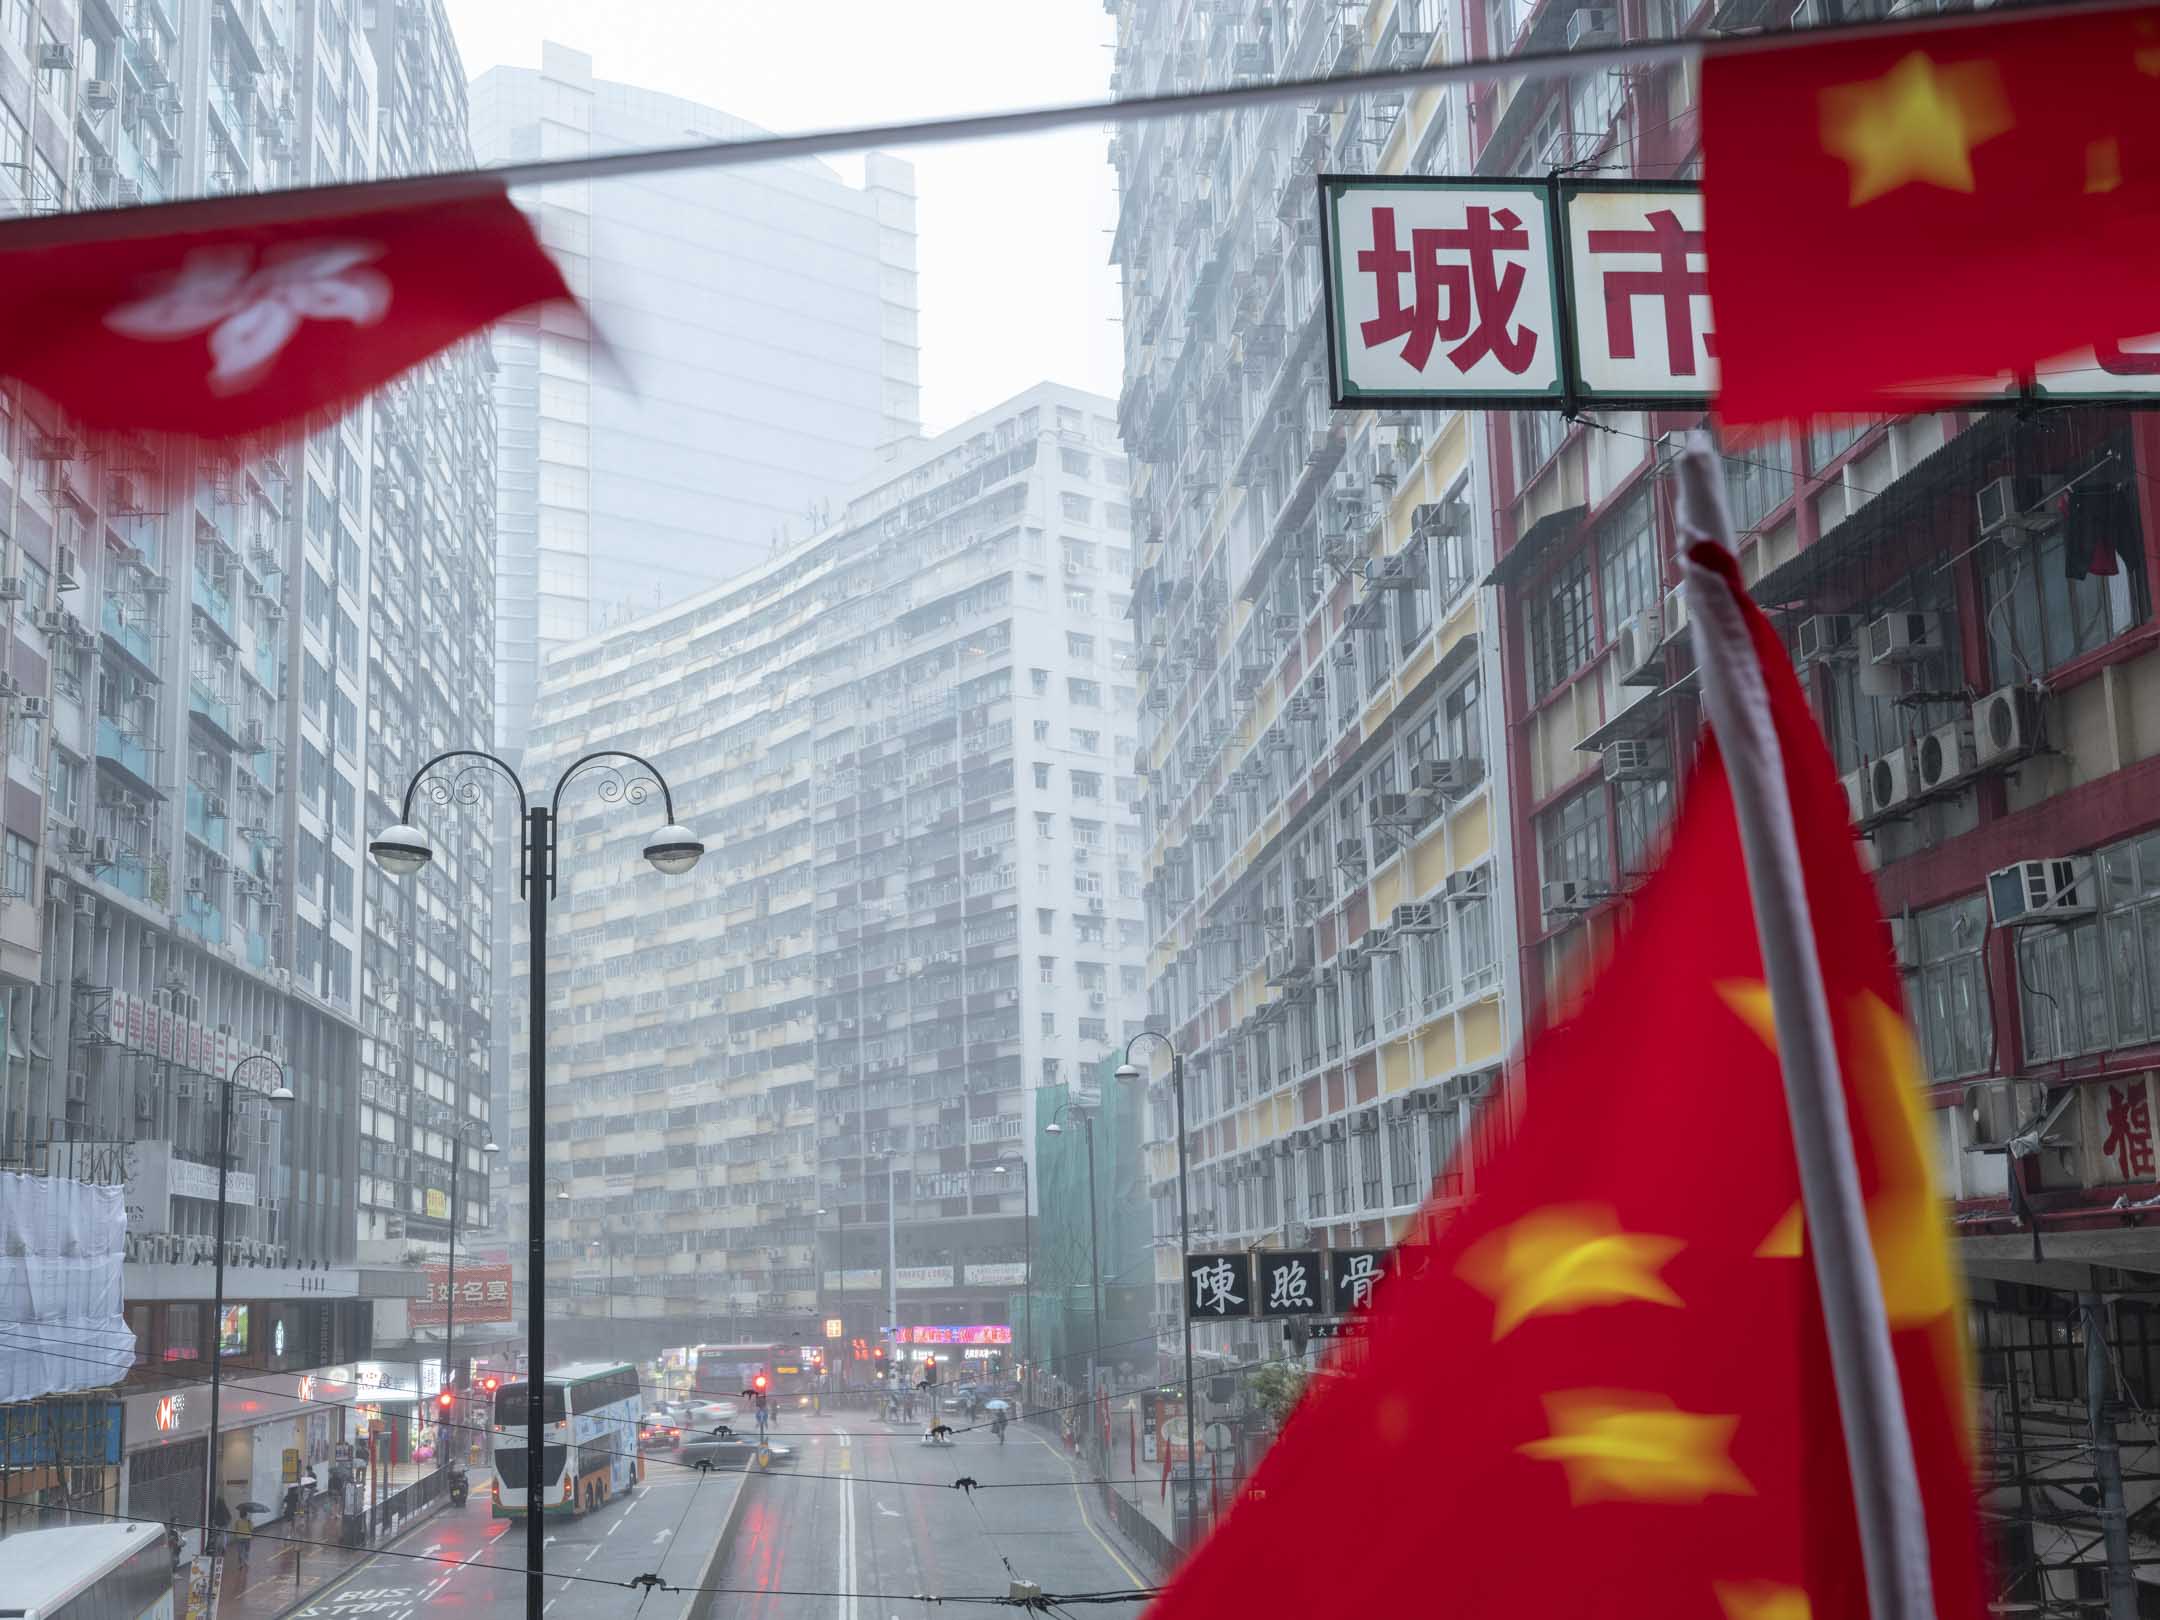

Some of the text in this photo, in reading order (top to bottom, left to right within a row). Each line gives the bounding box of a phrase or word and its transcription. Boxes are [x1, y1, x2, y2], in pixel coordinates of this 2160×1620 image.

[1192, 1256, 1385, 1315] 陳照骨
[333, 1587, 414, 1601] BUS
[296, 1600, 403, 1617] STOP
